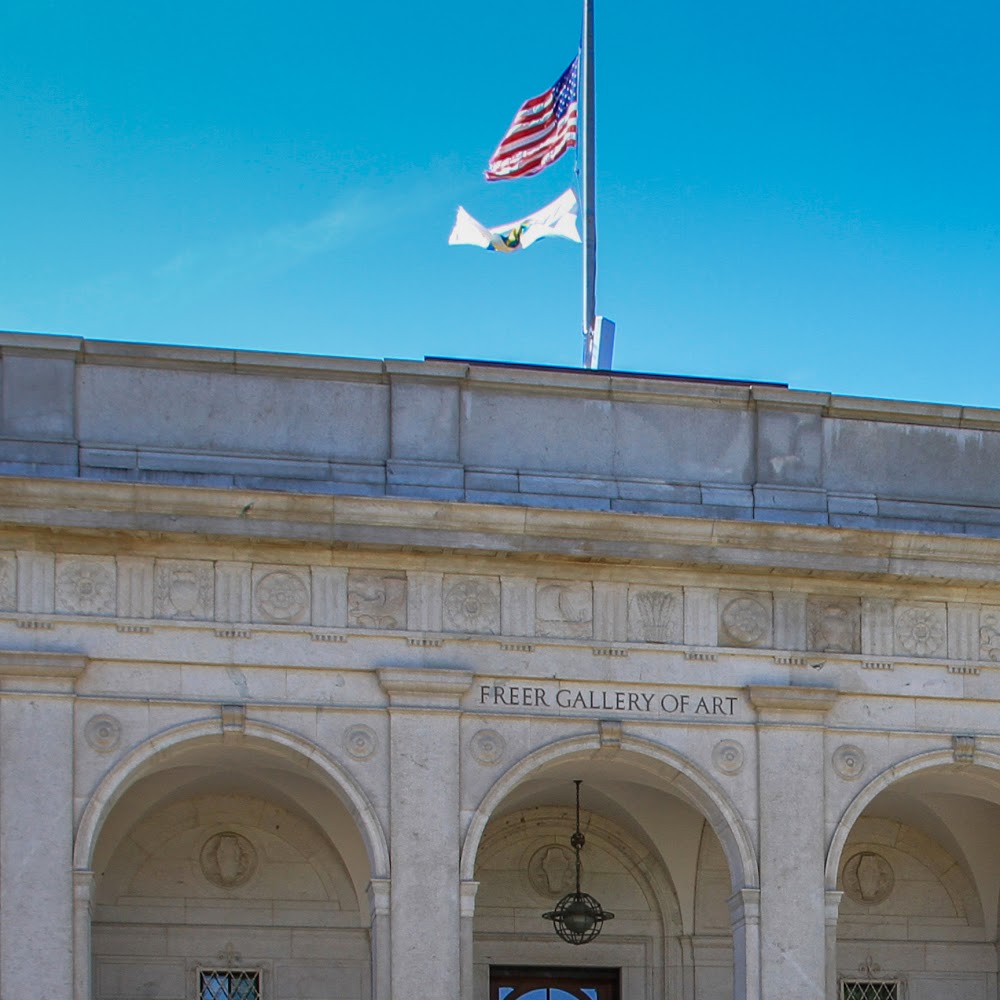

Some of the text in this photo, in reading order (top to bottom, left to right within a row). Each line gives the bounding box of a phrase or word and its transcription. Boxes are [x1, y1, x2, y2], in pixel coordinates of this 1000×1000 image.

[480, 686, 738, 715] FREER GALLERY OF ART
